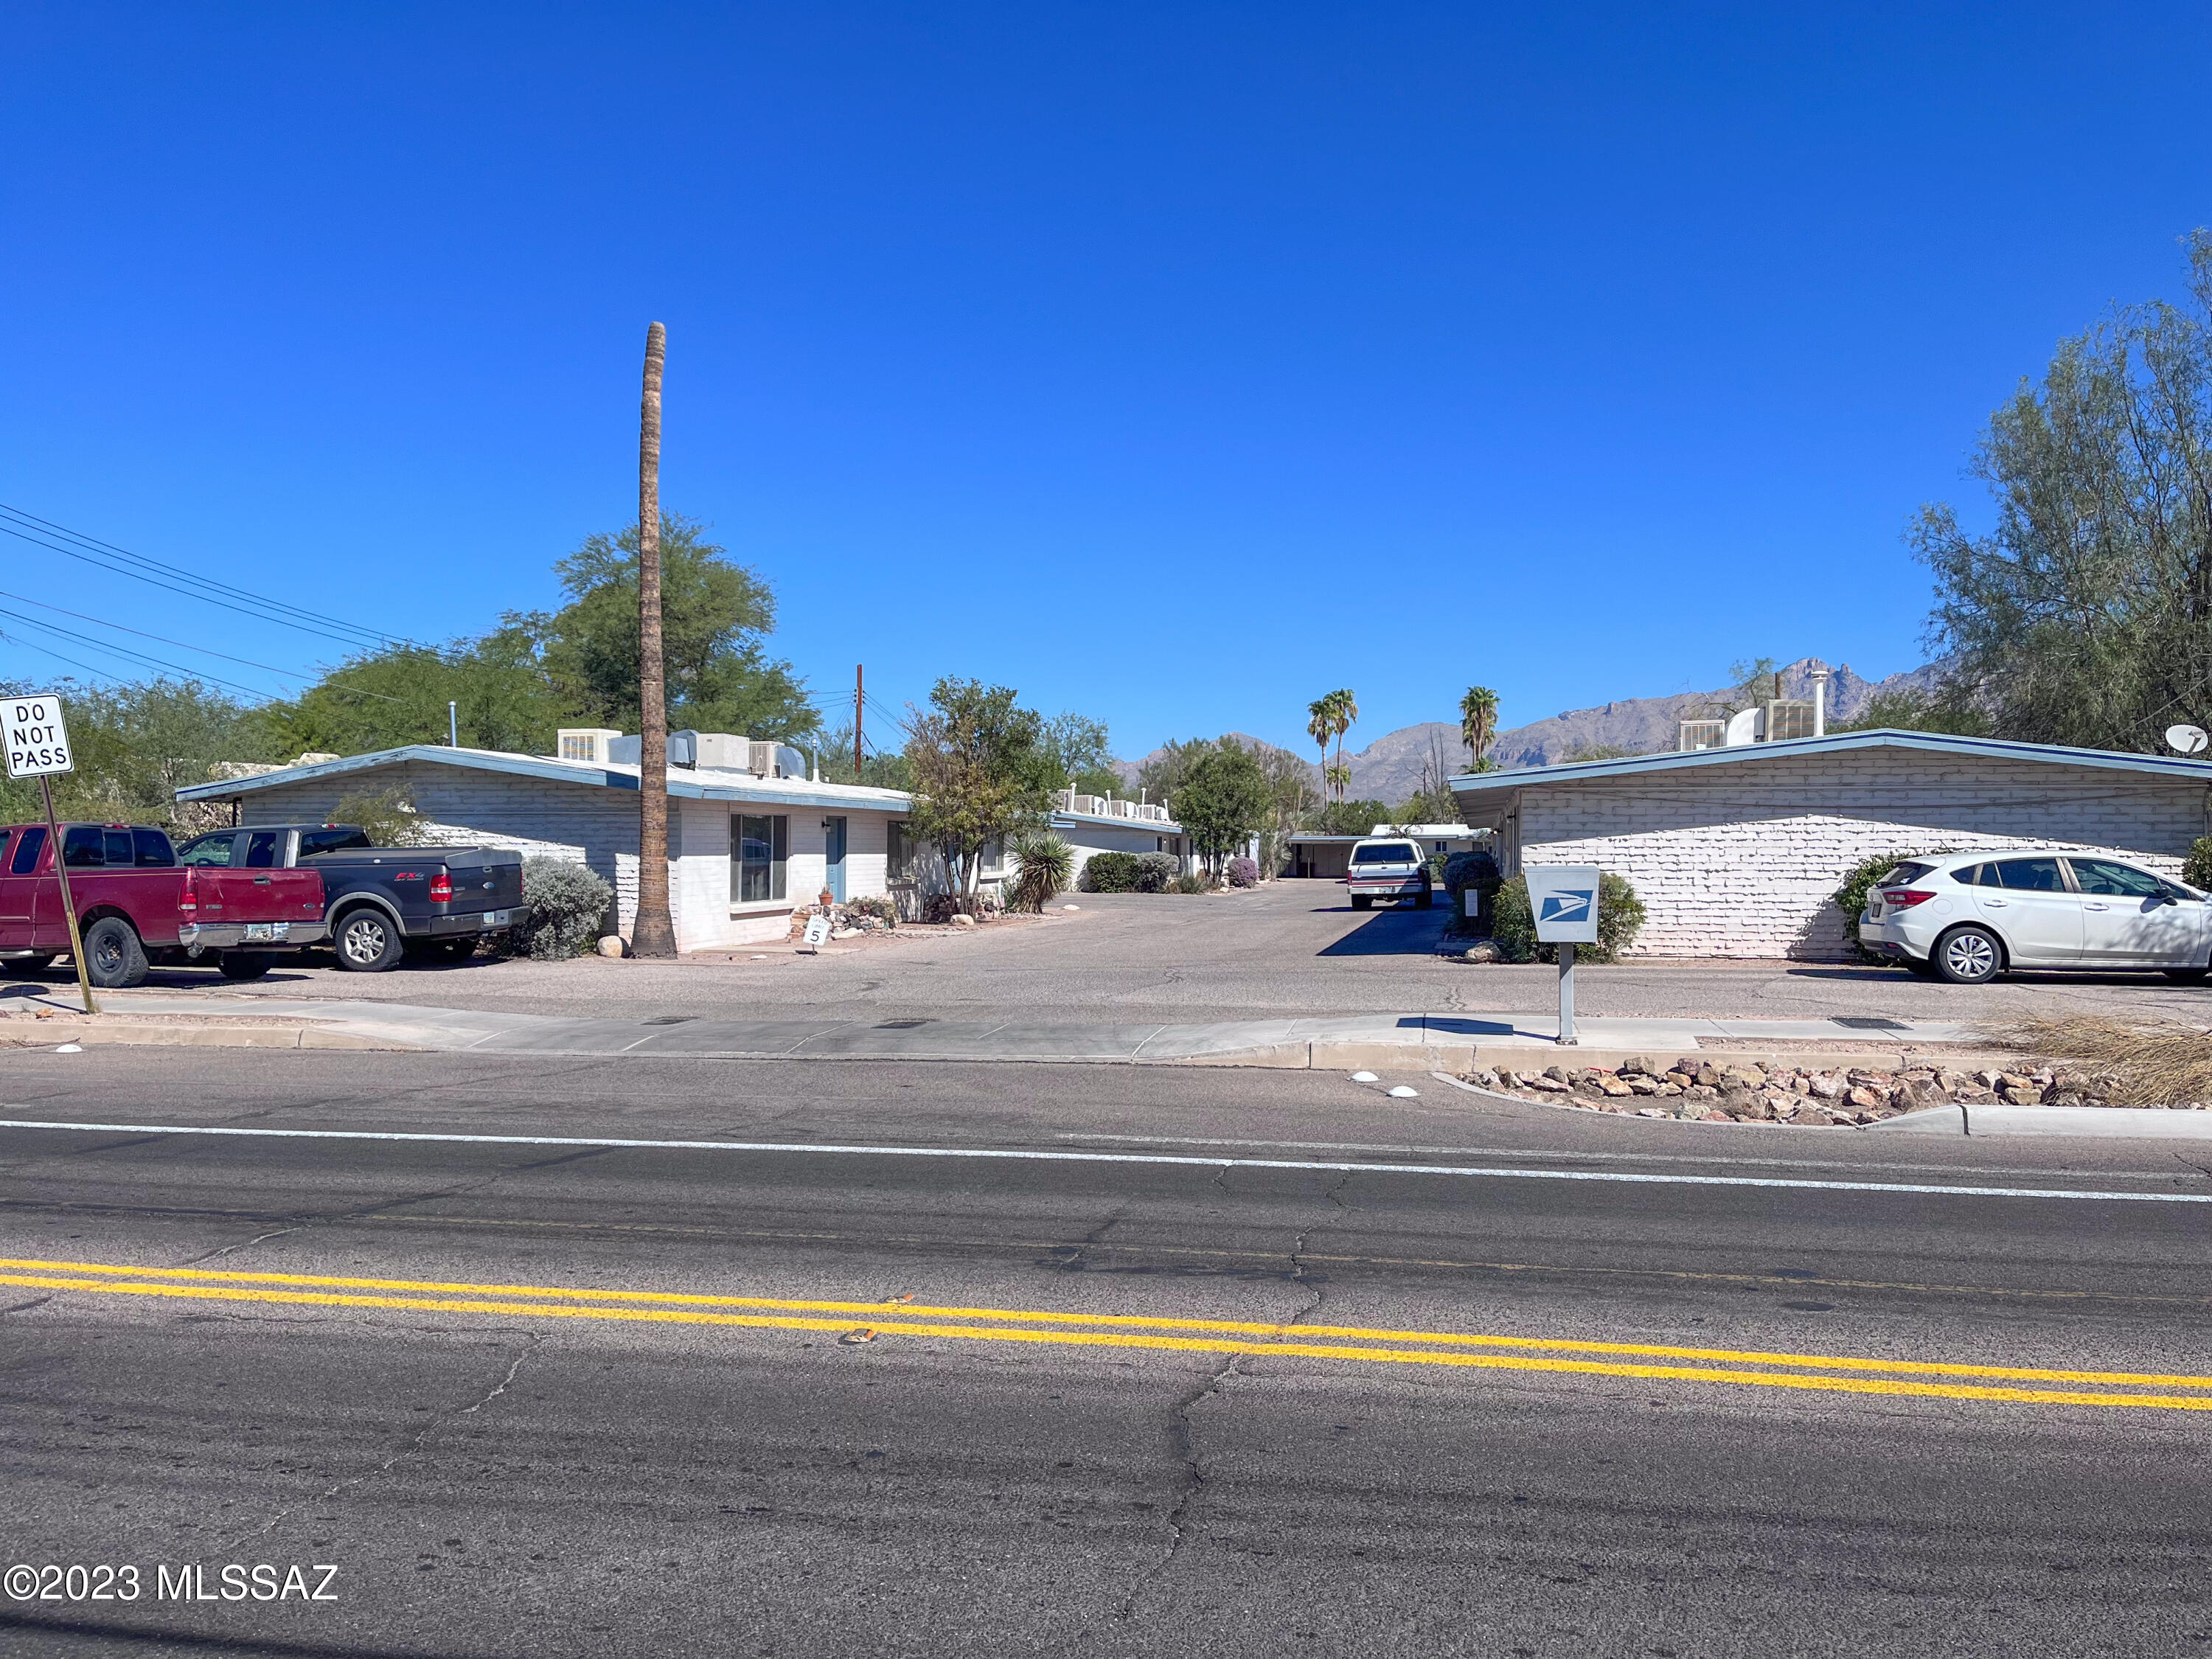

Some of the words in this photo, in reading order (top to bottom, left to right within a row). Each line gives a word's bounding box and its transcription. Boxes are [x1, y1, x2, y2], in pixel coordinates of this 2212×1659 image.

[16, 704, 44, 722] DO
[13, 726, 54, 745] NOT
[12, 748, 66, 769] PASS
[810, 931, 820, 942] 5
